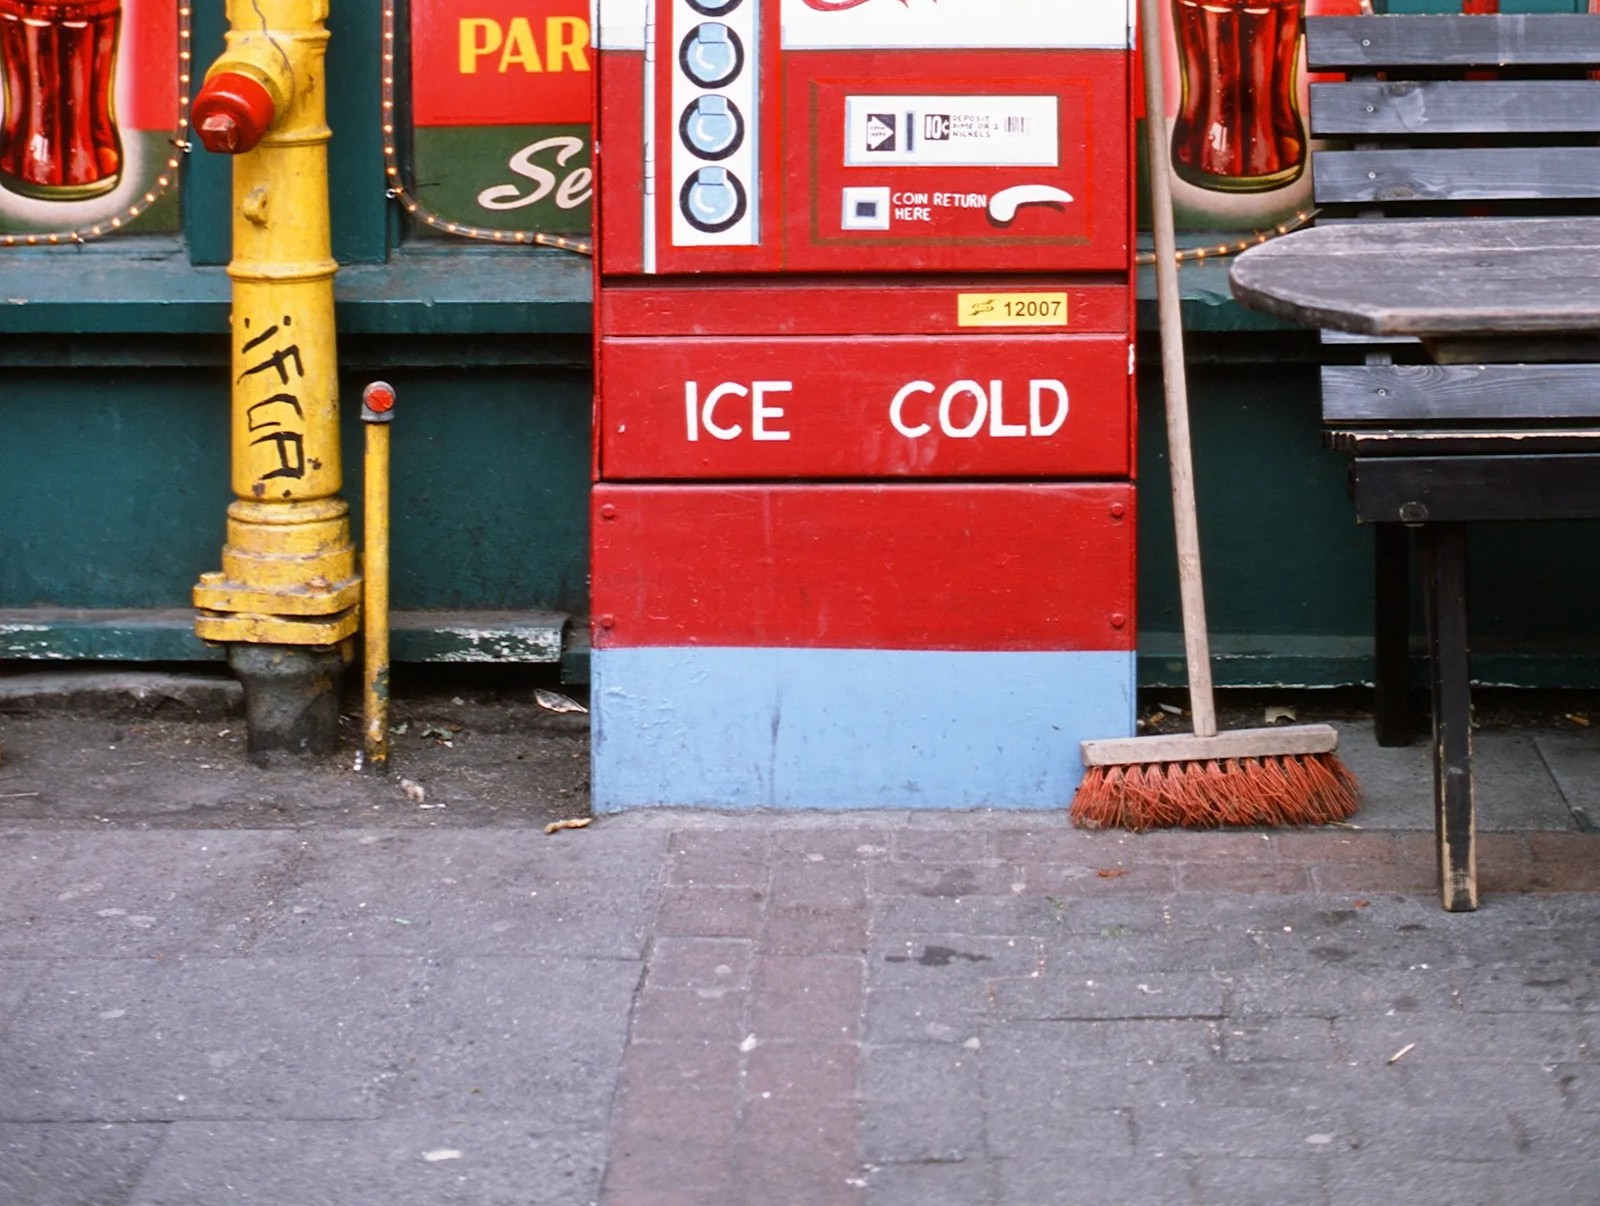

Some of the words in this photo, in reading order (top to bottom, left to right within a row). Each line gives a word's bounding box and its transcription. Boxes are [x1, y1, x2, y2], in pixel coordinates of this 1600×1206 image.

[458, 16, 591, 74] PAR
[952, 114, 990, 122] DEPOSIT
[993, 123, 1000, 131] 2
[477, 136, 592, 210] Se
[892, 192, 928, 205] COIN
[933, 192, 987, 208] RETURN
[894, 207, 931, 221] HERE
[1003, 301, 1062, 317] 12007
[684, 380, 793, 442] ICE
[889, 379, 1070, 439] COLD
